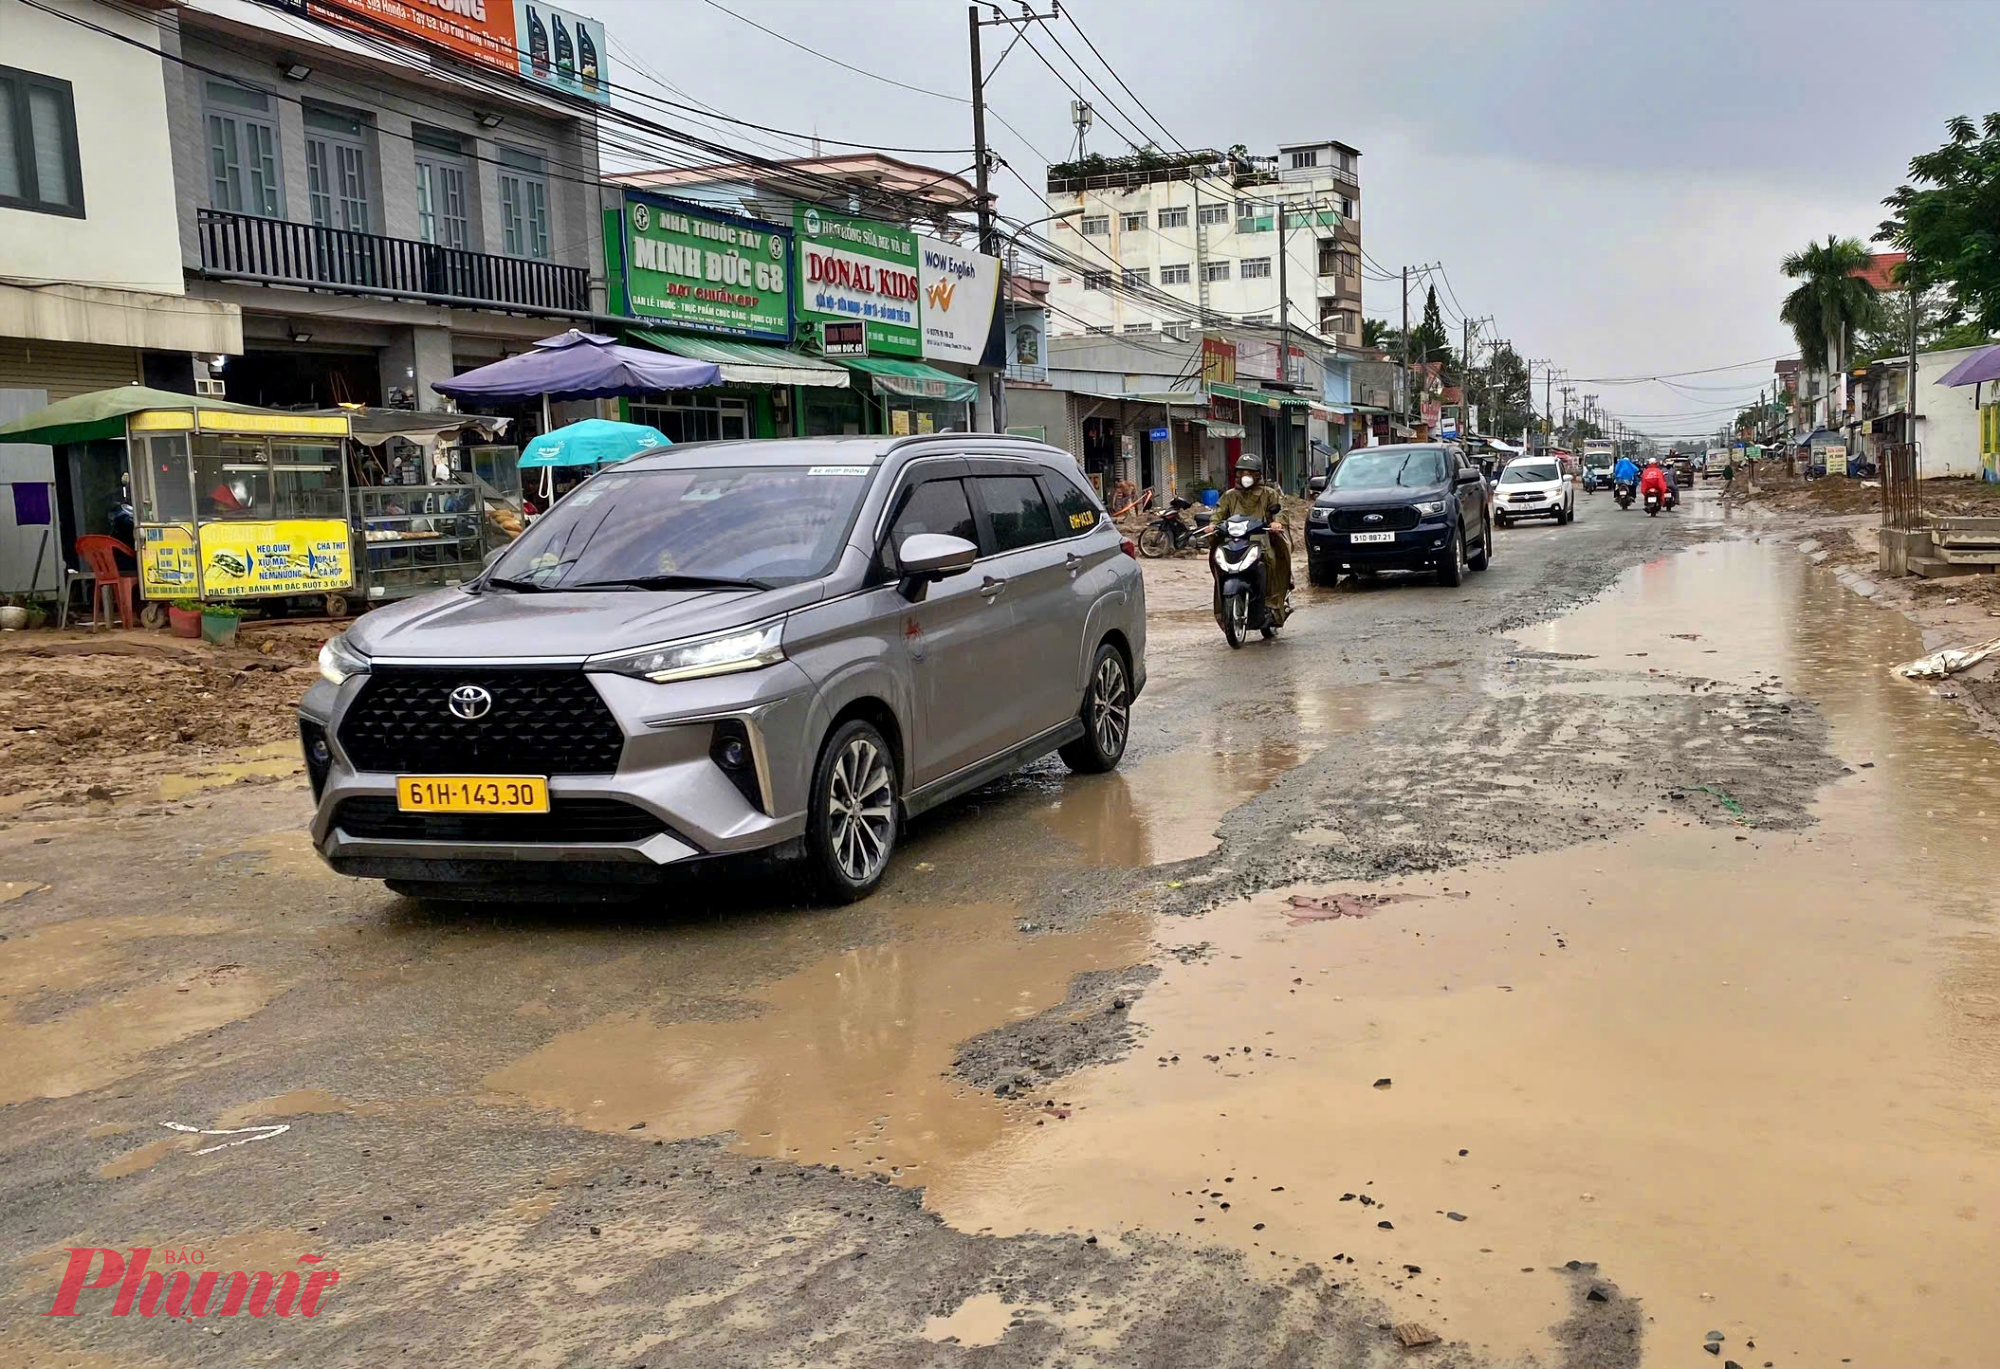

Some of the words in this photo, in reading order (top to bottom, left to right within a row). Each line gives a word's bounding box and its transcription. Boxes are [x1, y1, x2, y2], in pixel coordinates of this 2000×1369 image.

[659, 213, 689, 234] NHÀ
[692, 222, 736, 244] THUỐC
[738, 230, 762, 249] TÂY
[634, 236, 701, 279] MINH
[704, 248, 751, 287] ĐỨC
[755, 262, 784, 293] 68
[810, 253, 874, 293] DONAL
[879, 268, 919, 301] KIDS
[925, 250, 947, 271] WOW
[948, 257, 976, 280] English
[826, 344, 842, 353] MINH
[855, 344, 862, 352] 68
[256, 544, 271, 553] HEO
[272, 543, 290, 553] QUAY
[410, 783, 534, 805] 61H-143.30
